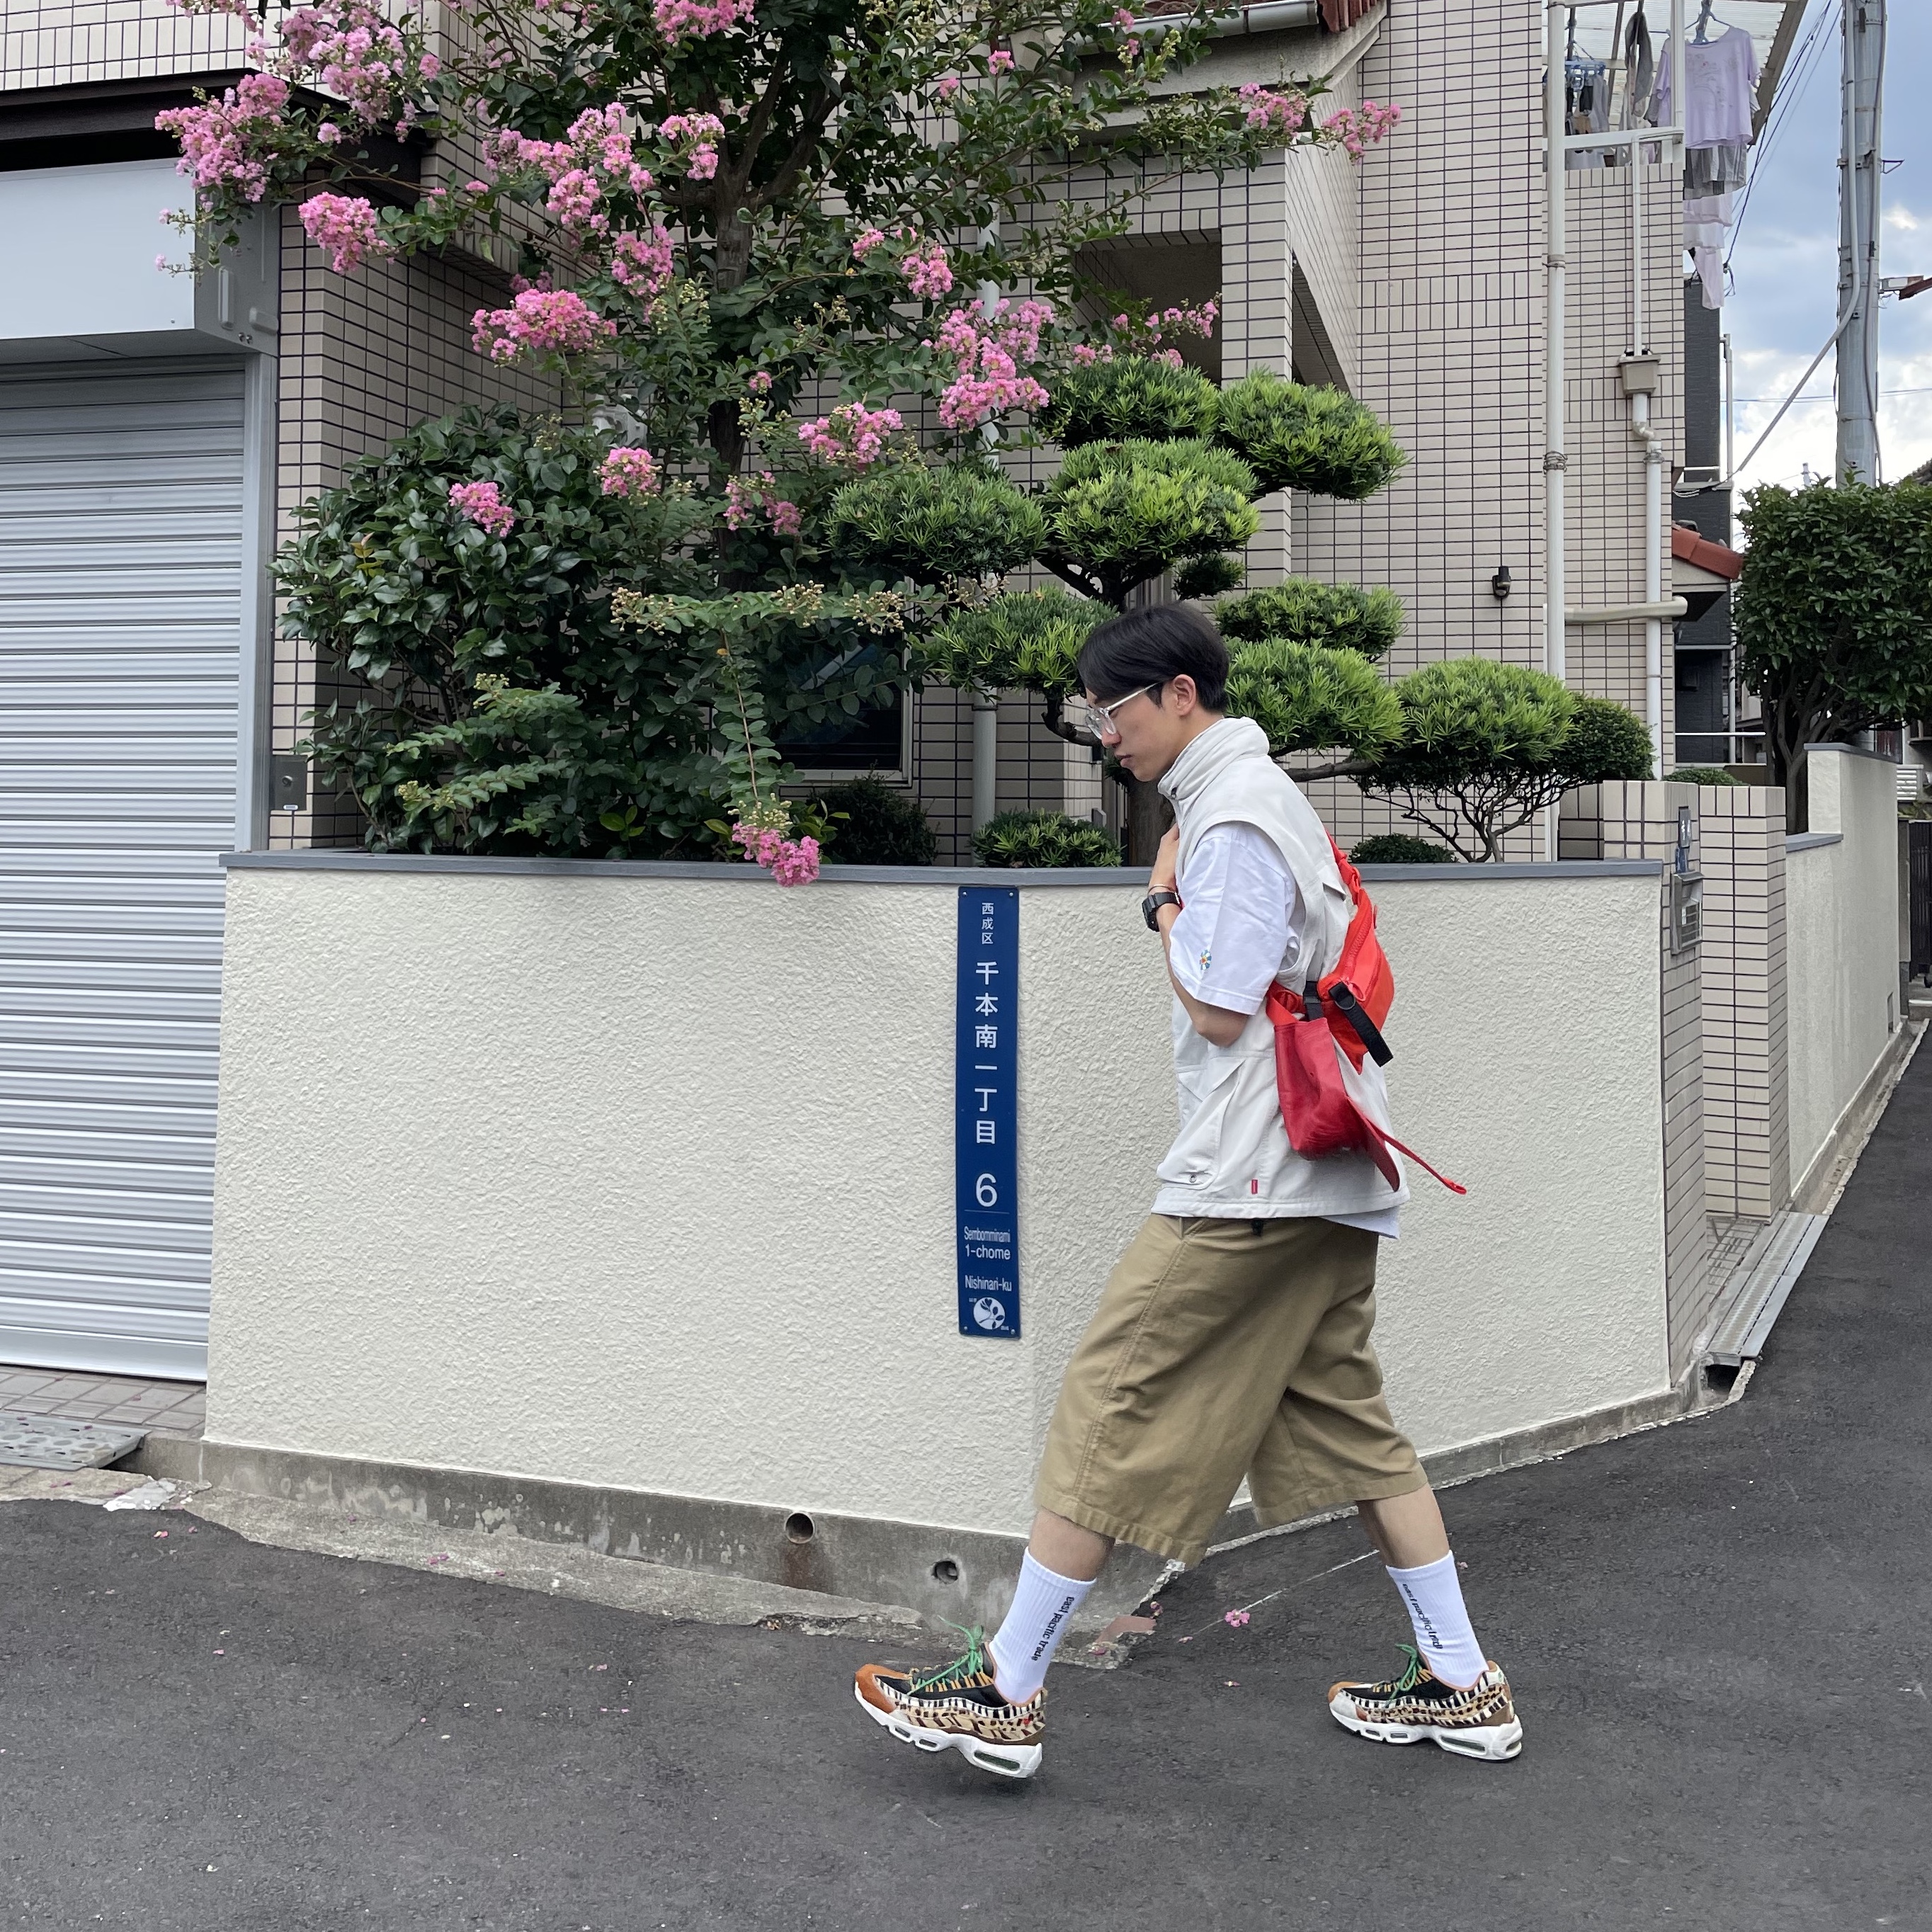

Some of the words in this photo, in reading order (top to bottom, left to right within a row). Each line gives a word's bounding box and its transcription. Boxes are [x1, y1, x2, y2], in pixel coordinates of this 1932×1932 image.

[982, 902, 994, 944] 西成区
[974, 961, 999, 1144] 千本南一丁目
[975, 1173, 998, 1207] 6
[965, 1244, 1011, 1260] 1-chome
[965, 1275, 1012, 1292] Nishinari-ku
